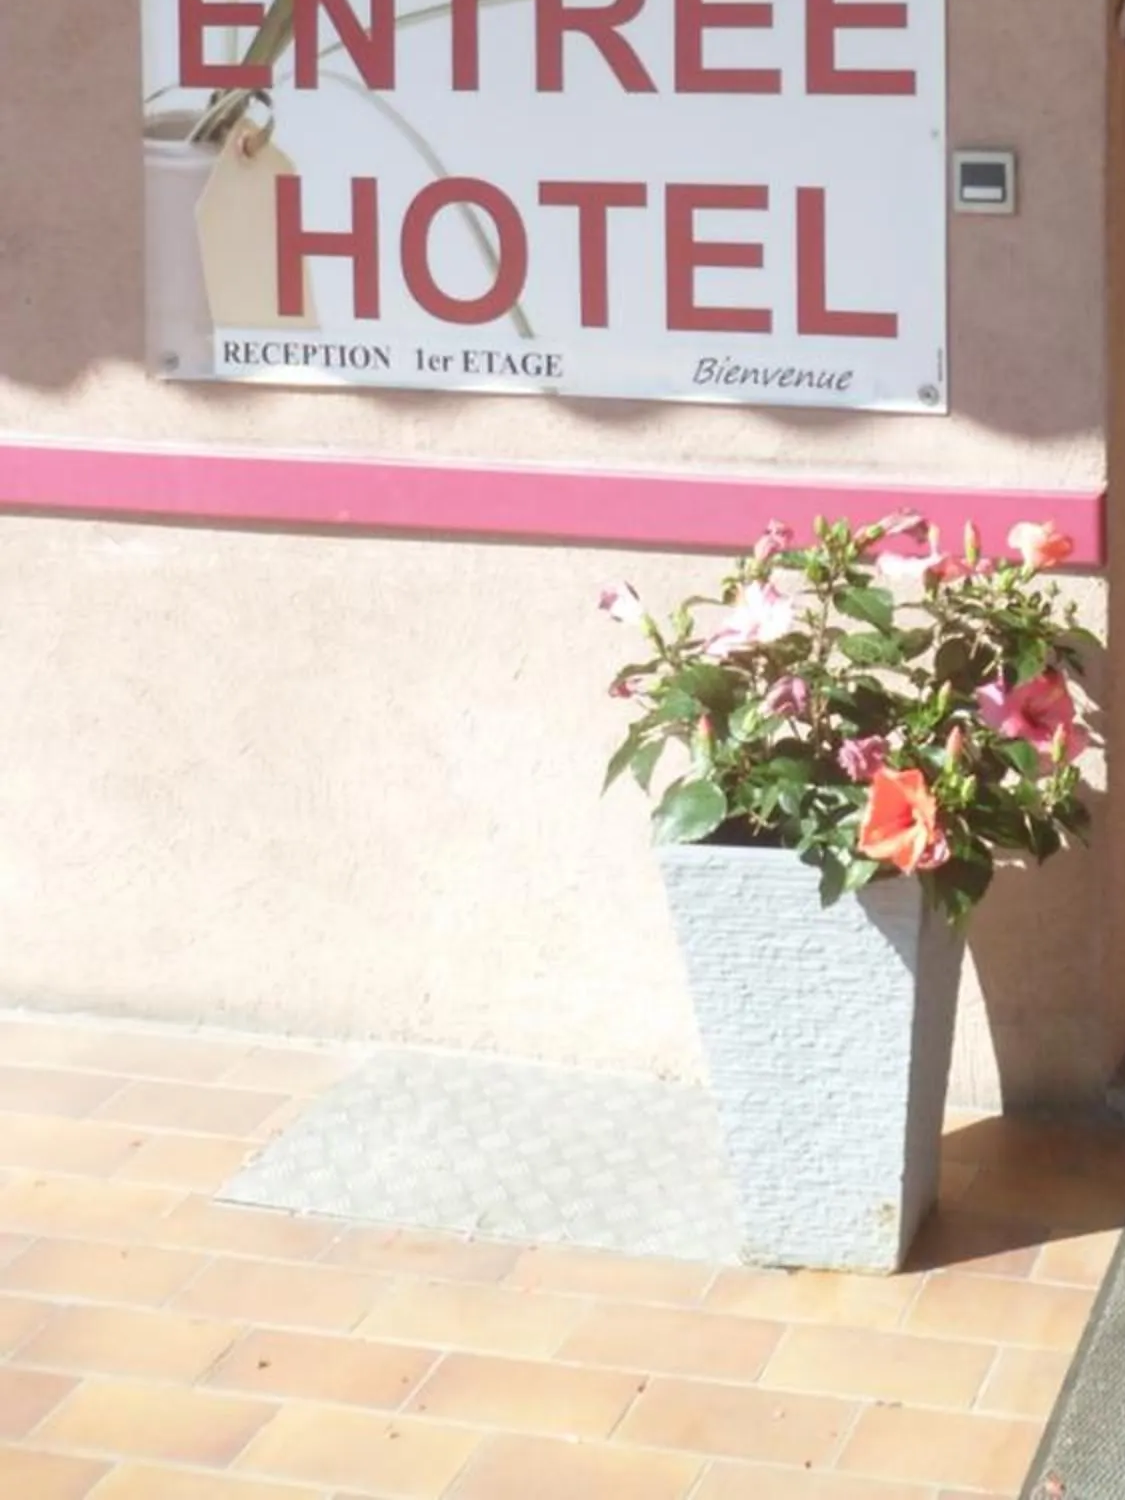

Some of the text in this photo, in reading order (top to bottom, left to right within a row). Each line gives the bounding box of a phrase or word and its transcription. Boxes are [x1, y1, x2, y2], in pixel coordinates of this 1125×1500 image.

[275, 174, 898, 339] HOTEL
[223, 340, 564, 378] RECEPTION 1er ETAGE
[692, 355, 854, 391] Bienvenue
